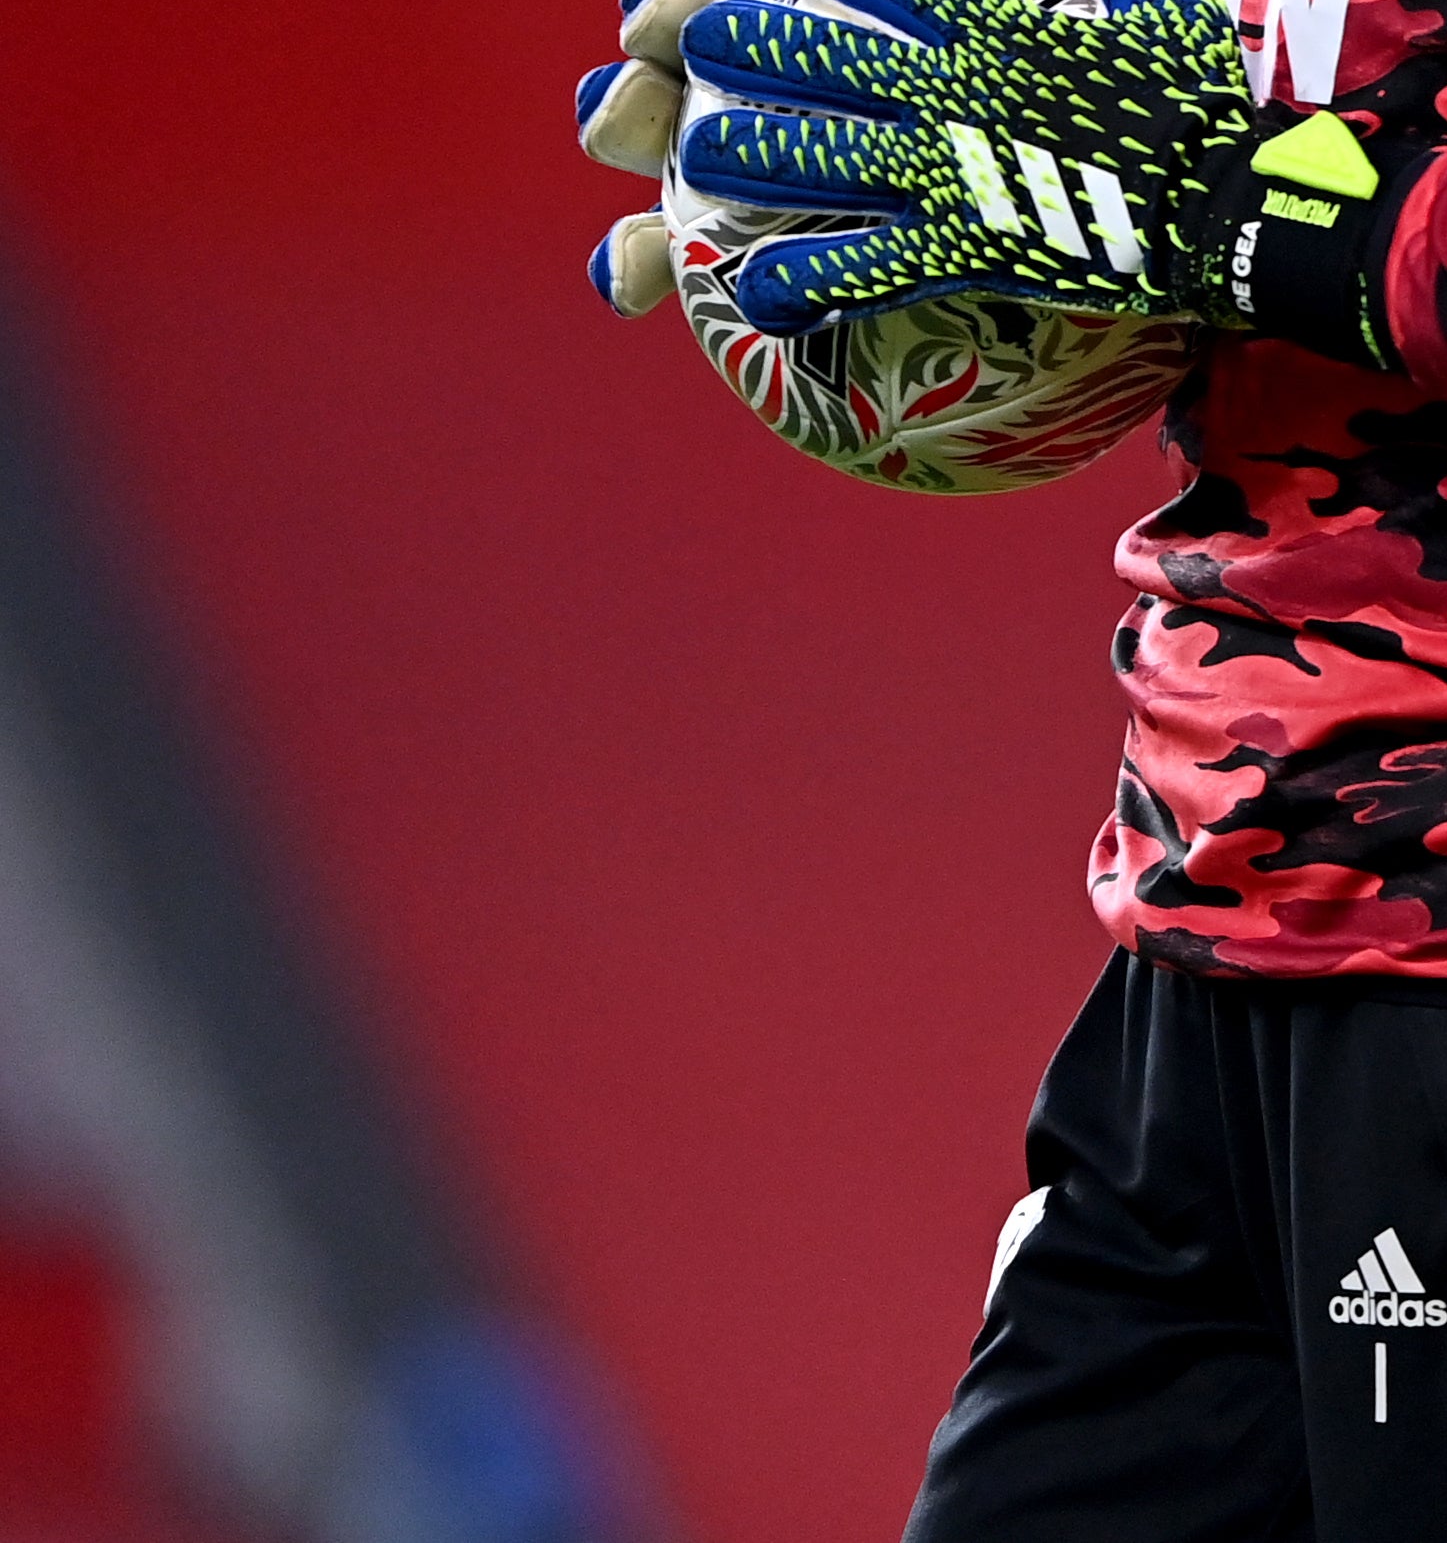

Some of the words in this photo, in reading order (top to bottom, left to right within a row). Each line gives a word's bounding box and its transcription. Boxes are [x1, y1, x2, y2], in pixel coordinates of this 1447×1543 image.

[1231, 220, 1263, 278] GEA
[1231, 280, 1256, 313] DE
[1329, 1292, 1447, 1328] adidas
